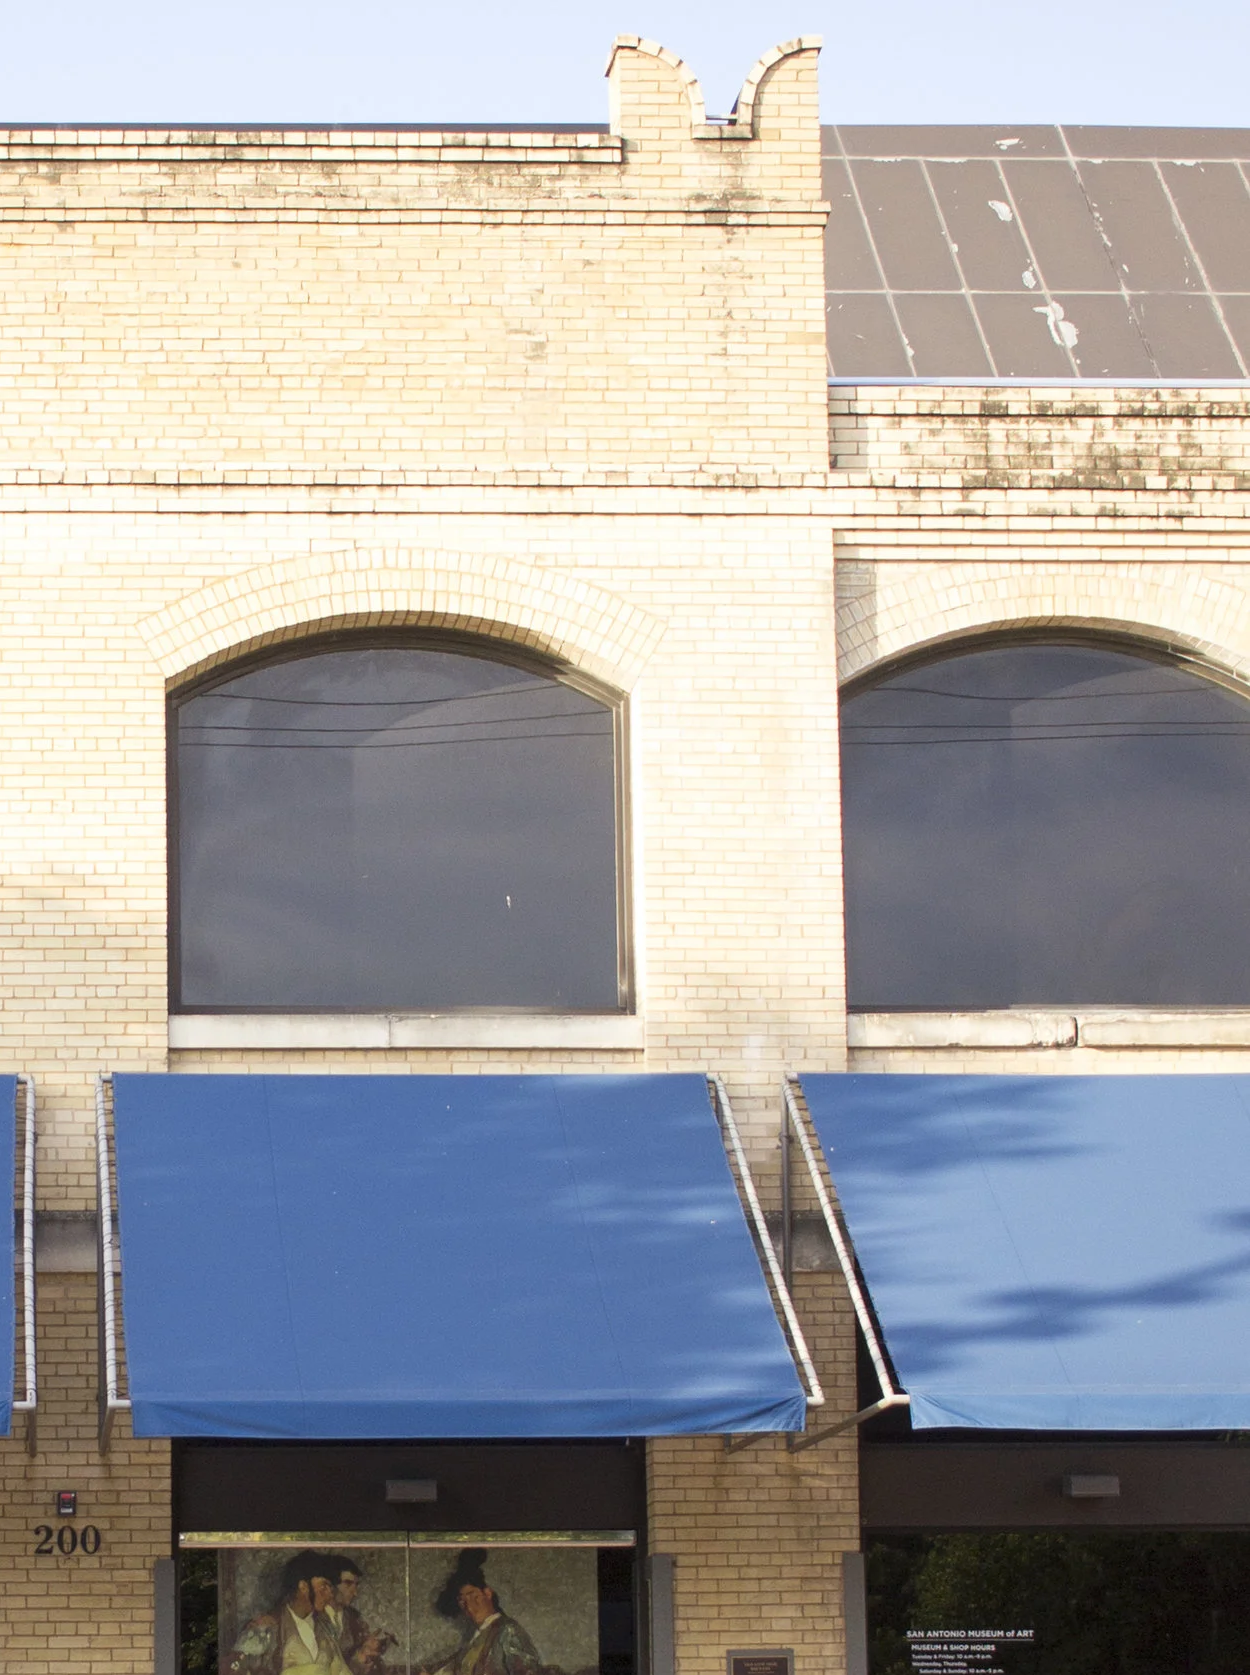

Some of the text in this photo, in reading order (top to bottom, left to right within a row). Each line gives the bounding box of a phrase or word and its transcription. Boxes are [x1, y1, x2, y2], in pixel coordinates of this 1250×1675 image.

[34, 1525, 101, 1555] 200
[906, 1630, 924, 1638] SAN
[926, 1630, 965, 1638] ANTONIO
